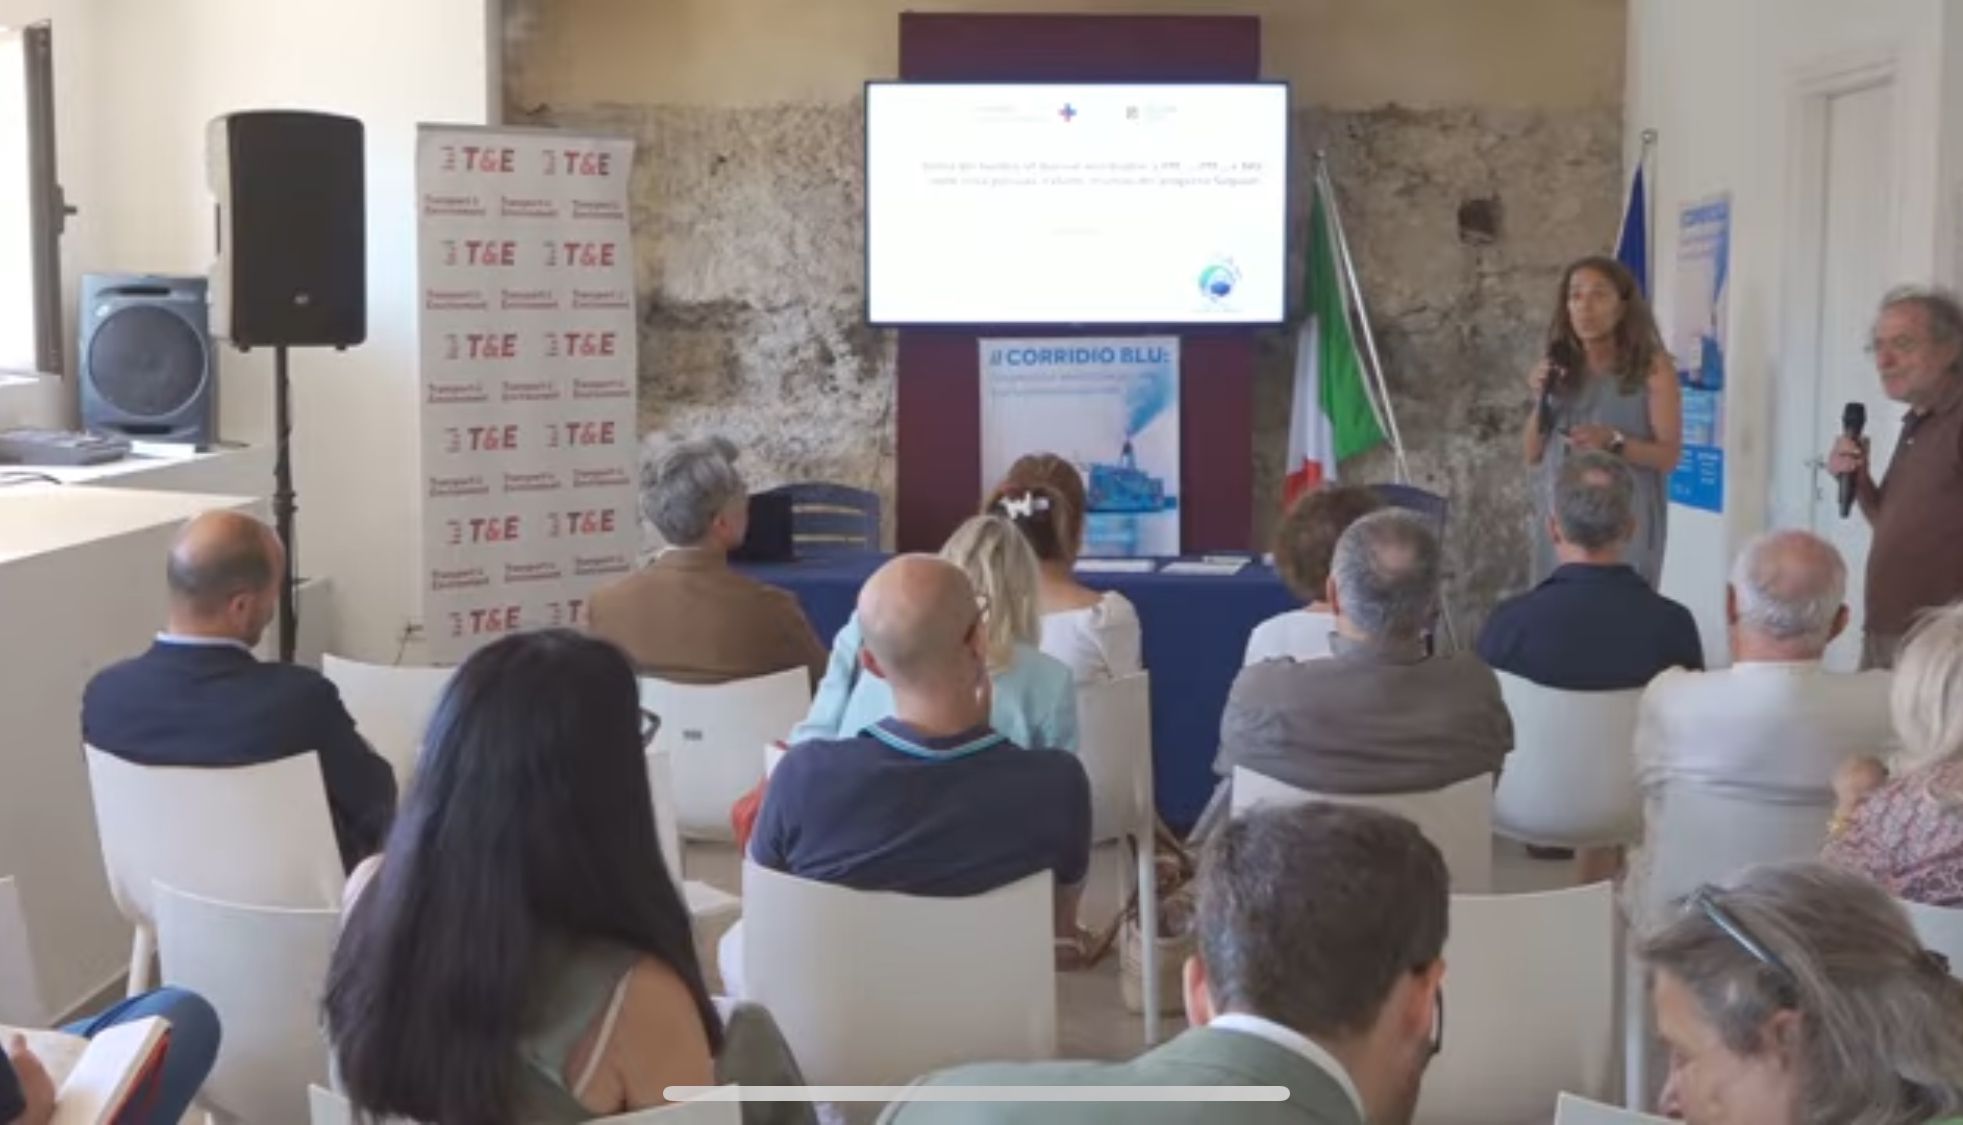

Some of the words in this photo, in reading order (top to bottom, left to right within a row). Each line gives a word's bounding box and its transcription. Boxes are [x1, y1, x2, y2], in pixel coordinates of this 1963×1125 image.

[463, 146, 515, 172] T&E
[564, 152, 611, 176] T&E
[465, 240, 517, 267] T&E
[564, 243, 615, 267] T&E
[467, 333, 518, 359] T&E
[565, 333, 615, 357] T&E
[1007, 347, 1115, 366] CORRIDIO
[468, 425, 518, 451] T&E
[566, 421, 615, 446] T&E
[469, 515, 519, 543] T&E
[566, 509, 615, 535] T&E
[470, 606, 521, 634] T&E
